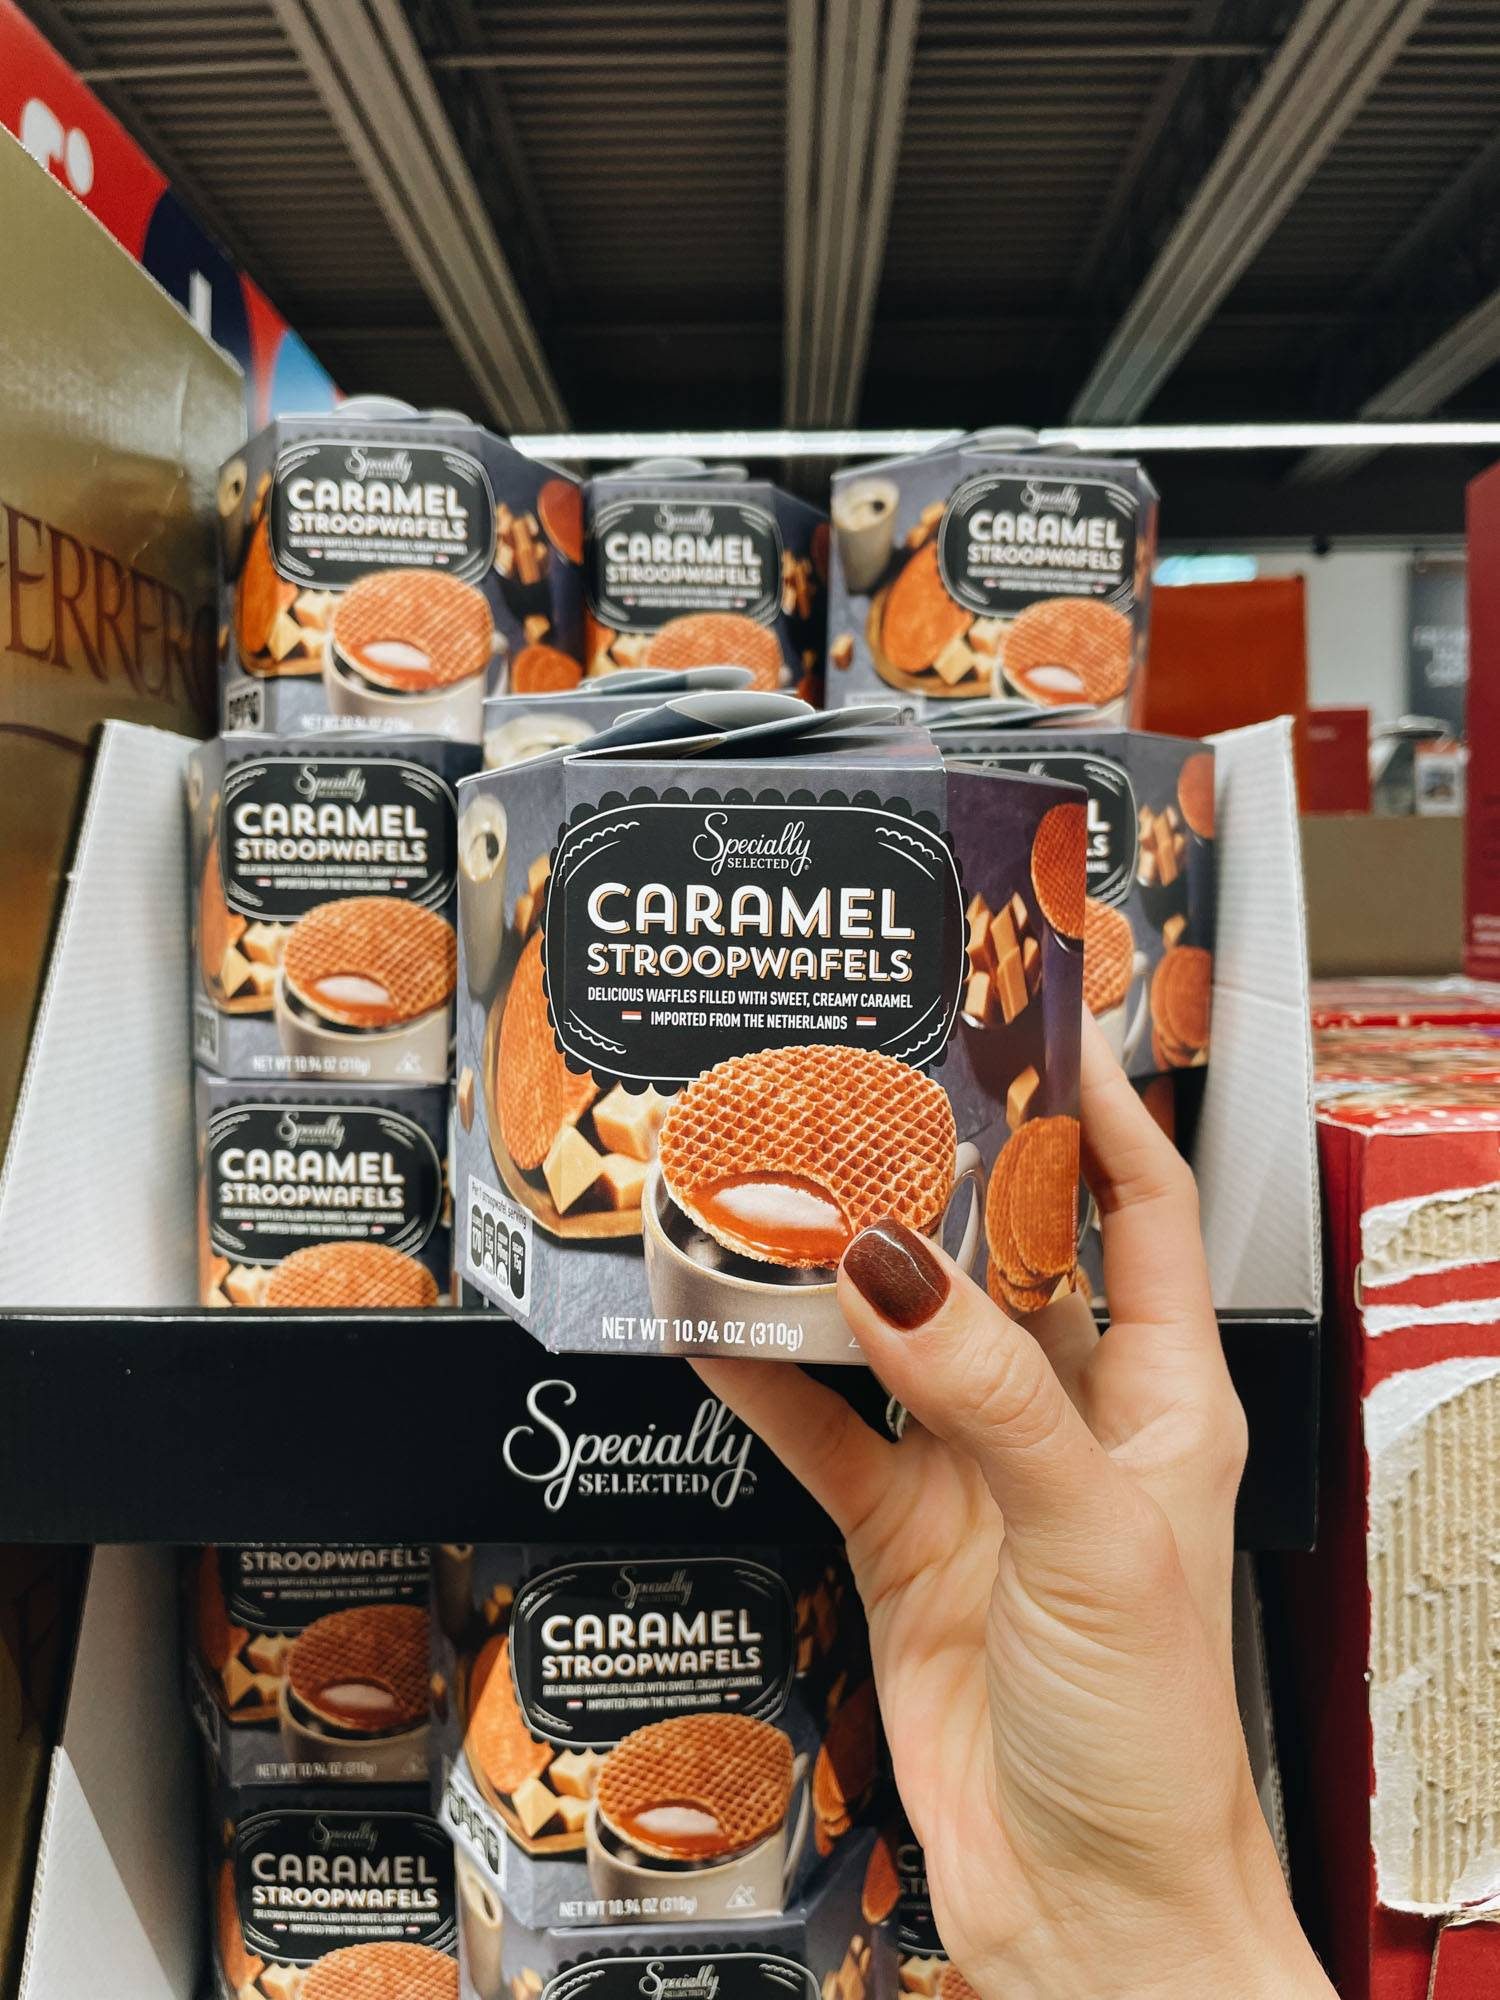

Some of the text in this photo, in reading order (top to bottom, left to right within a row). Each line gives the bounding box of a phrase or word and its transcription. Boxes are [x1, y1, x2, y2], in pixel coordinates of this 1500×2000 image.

[287, 478, 468, 518] CARAMEL
[288, 511, 467, 540] STROOPWAFELS
[968, 509, 1124, 549] CARAMEL
[605, 532, 761, 566] CARAMEL
[967, 542, 1122, 570] STROOPWAFELS
[605, 564, 761, 585] STROOPWAFELS
[234, 802, 428, 838] CARAMEL
[235, 837, 427, 862] STROOPWAFELS
[692, 811, 812, 876] Specially
[727, 858, 789, 869] SELECTED
[587, 882, 915, 940] CARAMEL
[586, 943, 913, 981] STROOPWAFELS
[587, 987, 913, 1008] DELICIOUS WAFFLES FILLED WITH SWEET, CREAMY CARAMEL
[650, 1010, 848, 1030] IMPORTED FROM THE NETHERLANDS
[218, 1148, 405, 1184] CARAMEL
[219, 1182, 404, 1208] STROOPWAFELS
[602, 1316, 803, 1351] NET WT 10.94 OZ (310g)
[502, 1379, 757, 1512] Specially
[578, 1472, 710, 1495] SELECTED
[240, 1548, 430, 1571] STROOPWAFELS
[541, 1609, 762, 1650] CARAMEL
[542, 1647, 761, 1679] STROOPWAFELS
[251, 1852, 438, 1884] CARAMEL
[252, 1885, 438, 1909] STROOPWAFELS
[559, 1901, 583, 1917] NET
[586, 1900, 605, 1917] WT
[608, 1898, 640, 1916] 10.94
